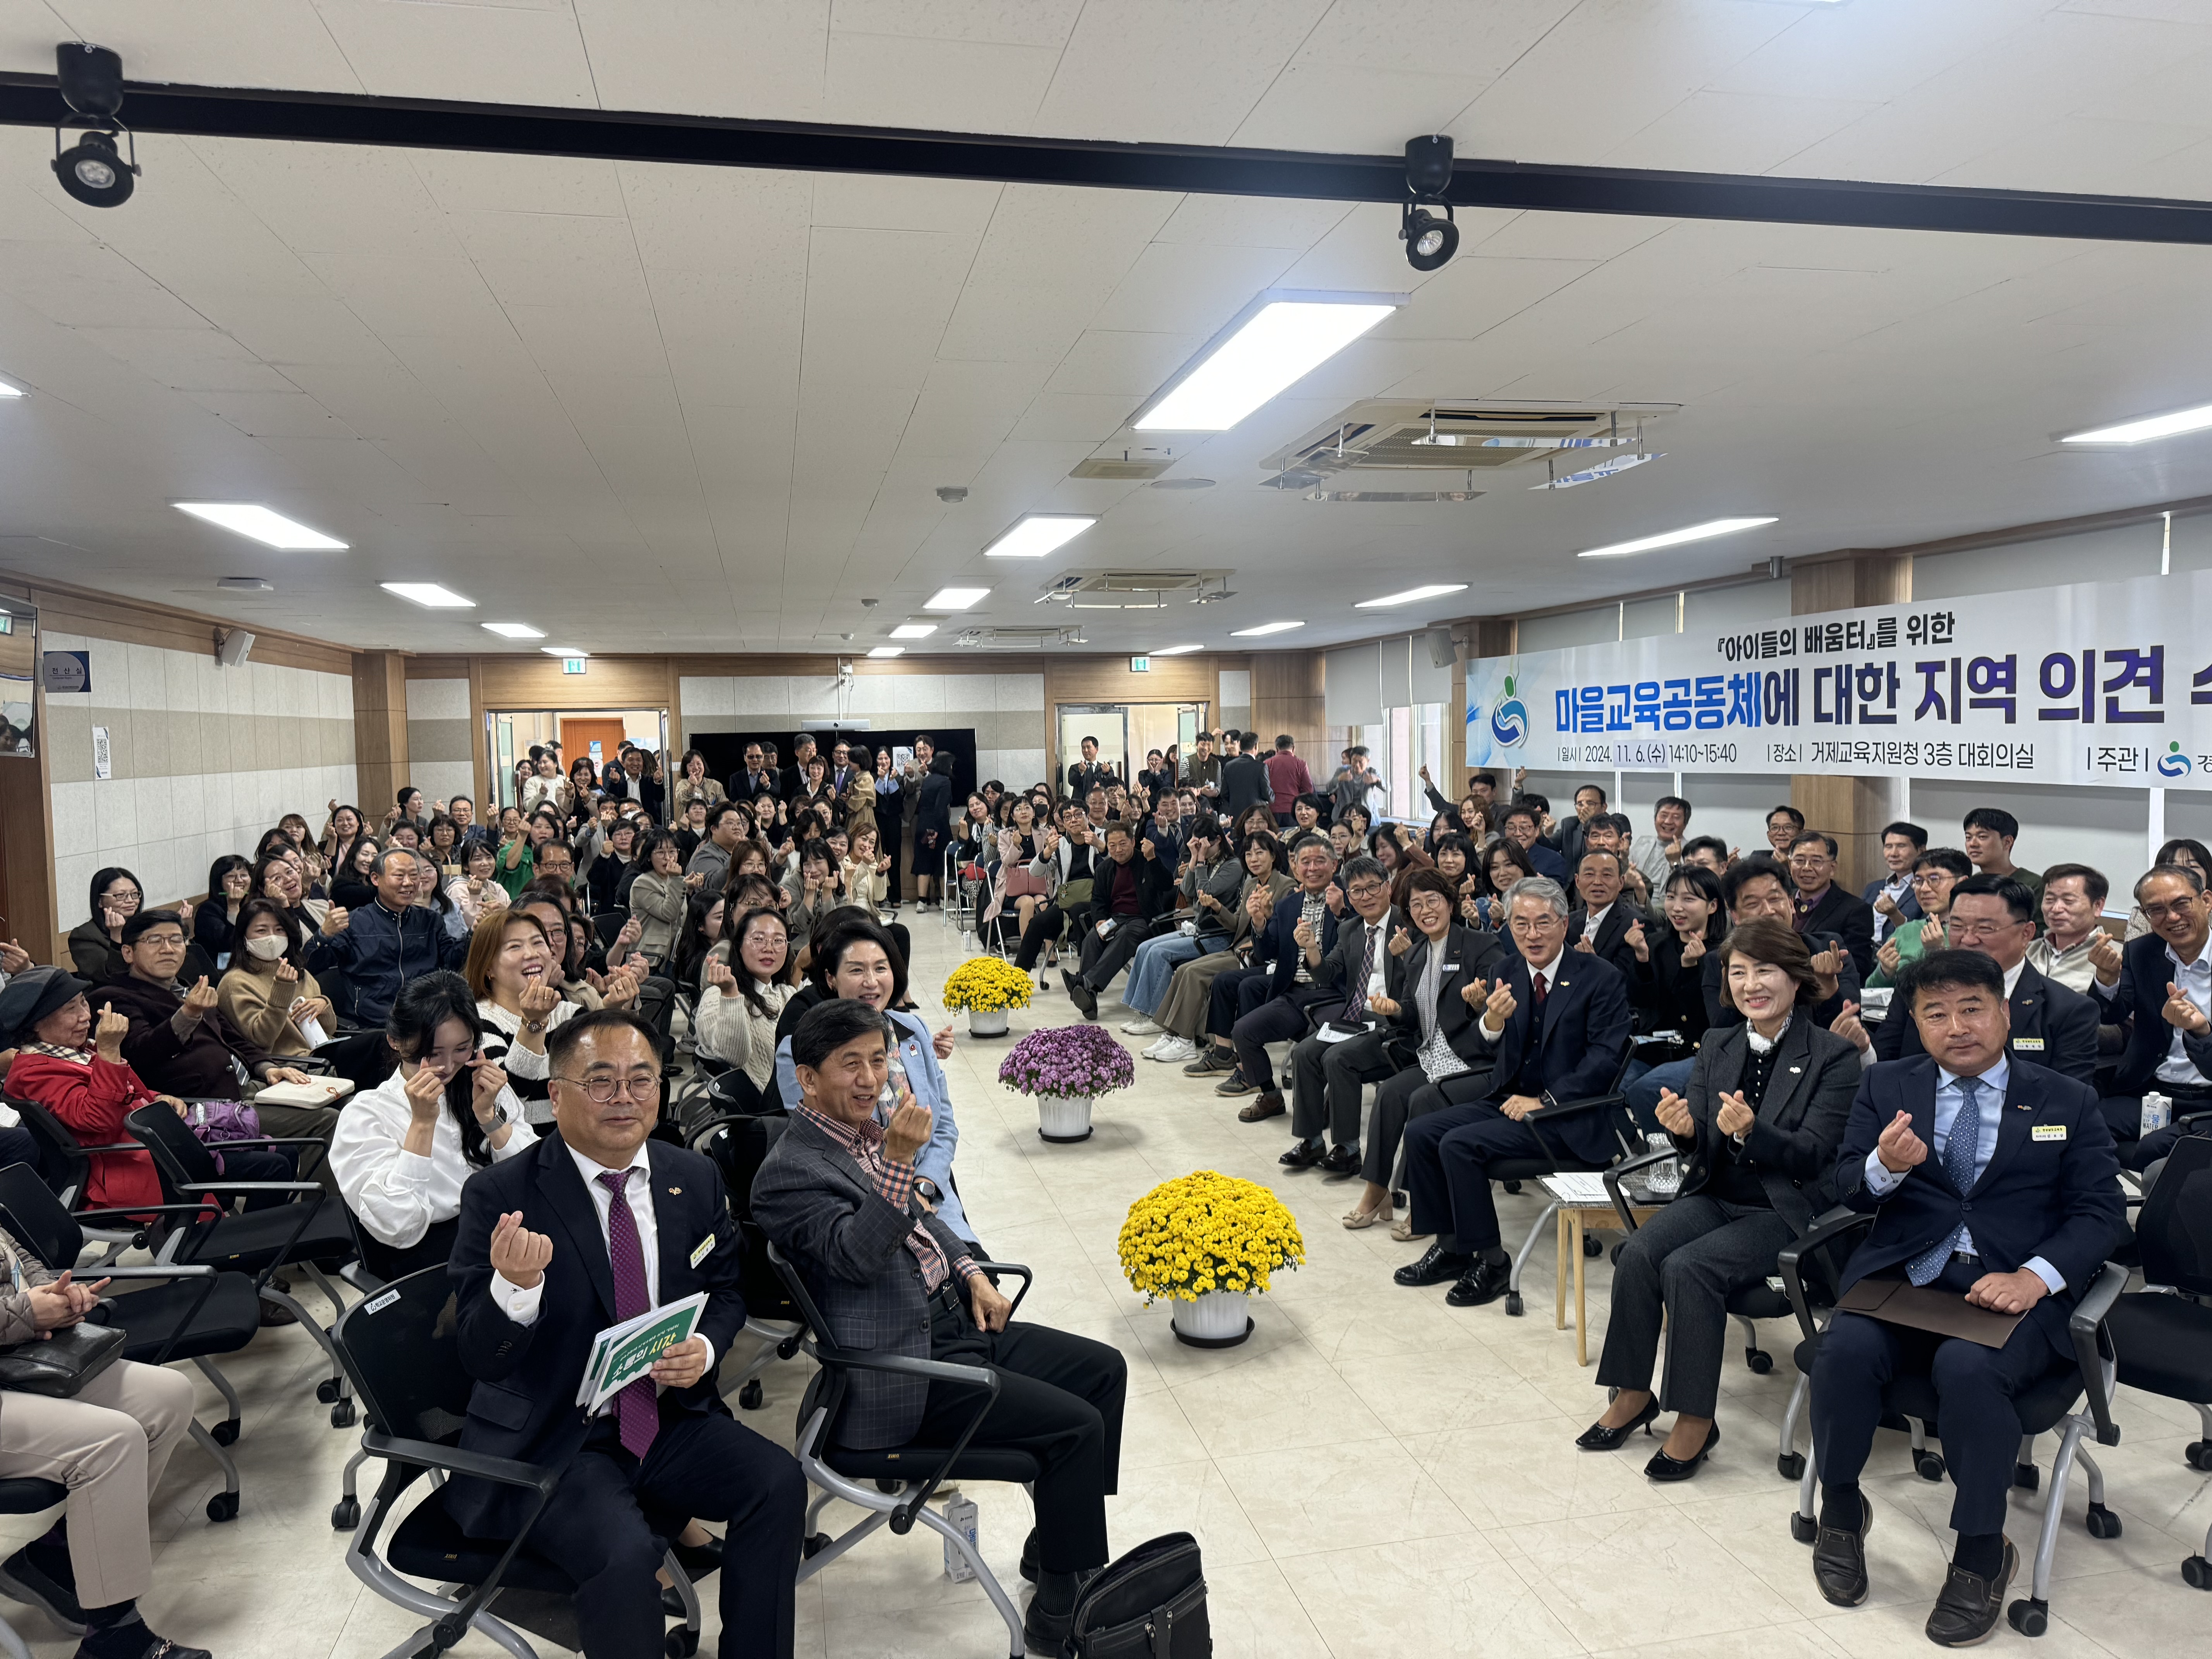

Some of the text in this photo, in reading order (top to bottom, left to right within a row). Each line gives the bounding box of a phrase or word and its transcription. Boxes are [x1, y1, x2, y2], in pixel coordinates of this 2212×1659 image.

[1718, 611, 1955, 661] 『아이들의 배움터』를 위한
[1556, 668, 1799, 732] 마을교육공동체에
[1814, 662, 1900, 725] 대한
[1915, 654, 2016, 724] 지역
[2039, 645, 2164, 724] 의견
[1586, 745, 1612, 763] 2024.
[1618, 745, 1631, 763] 11.
[1669, 743, 1737, 763] 14:10~15:40
[1811, 741, 1918, 765] 거제교육지원청
[1924, 742, 1952, 766] 3층
[1958, 742, 2033, 769] 대회의실
